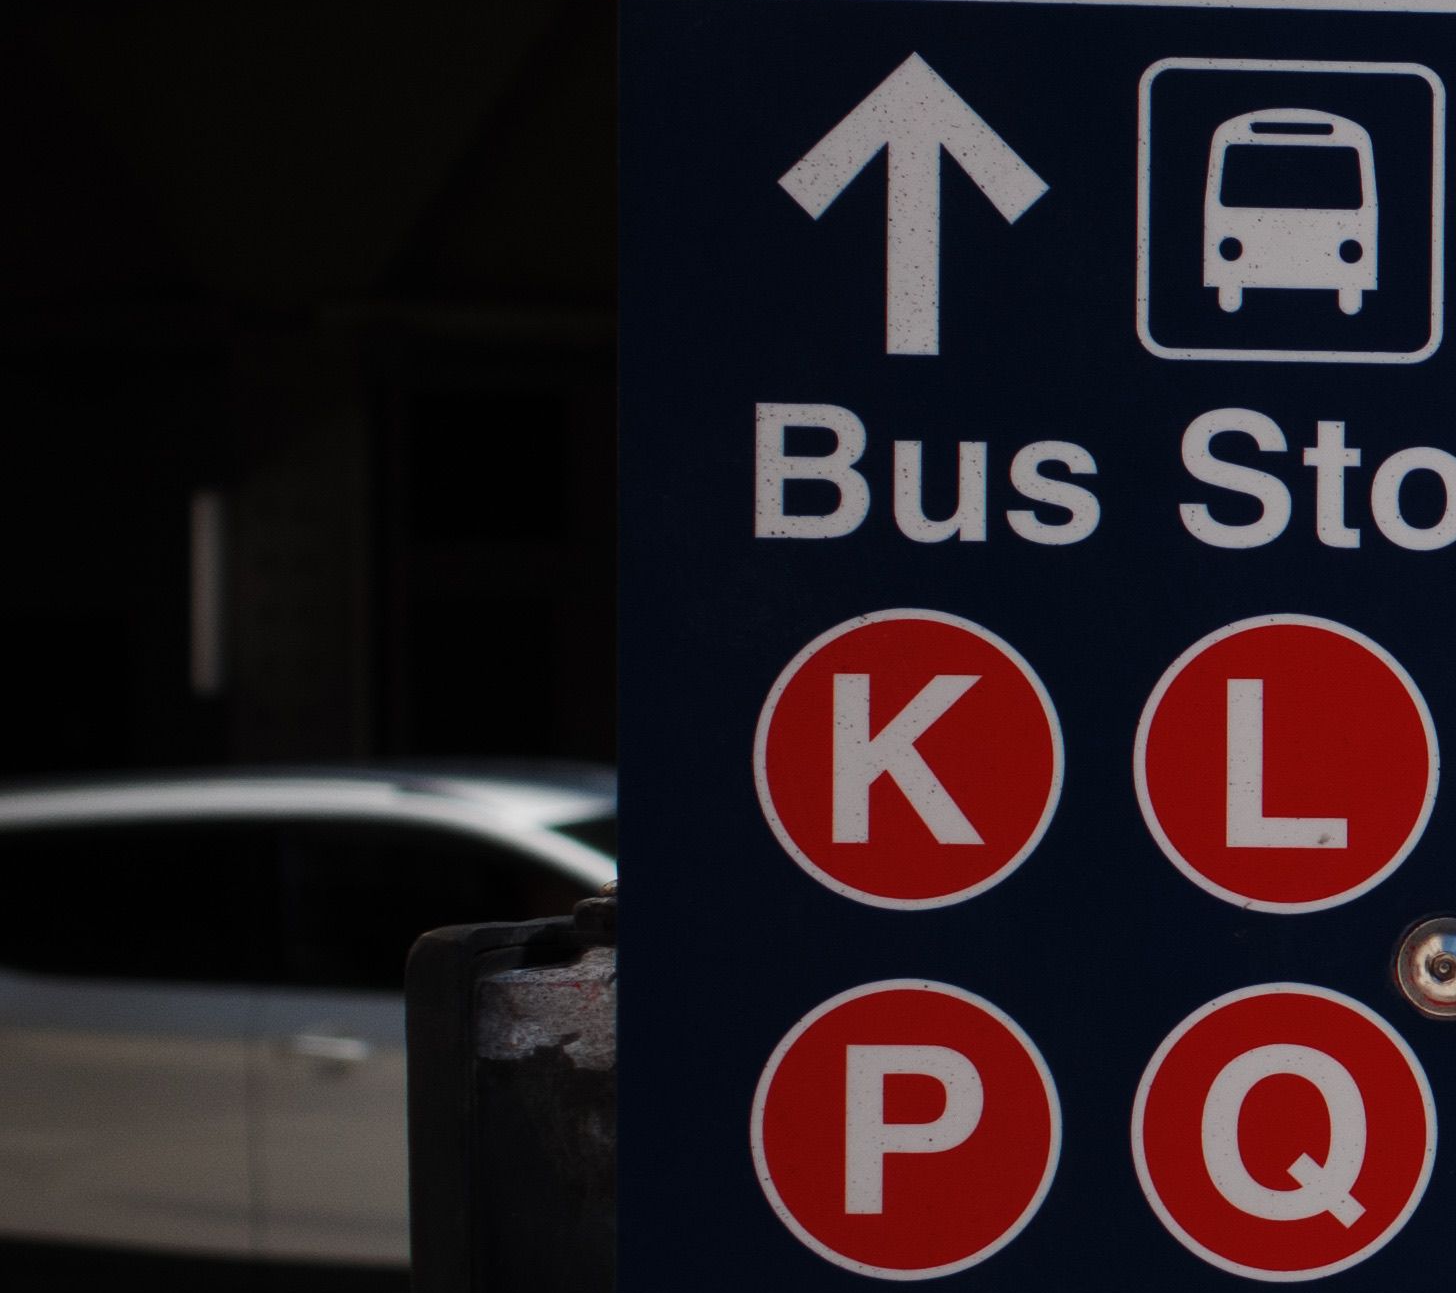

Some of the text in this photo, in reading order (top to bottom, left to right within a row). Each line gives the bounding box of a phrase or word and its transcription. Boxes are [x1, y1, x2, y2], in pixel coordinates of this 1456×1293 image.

[755, 403, 1101, 546] Bus
[831, 673, 985, 846] K
[1226, 679, 1348, 849] L
[844, 1043, 1368, 1230] P Q
